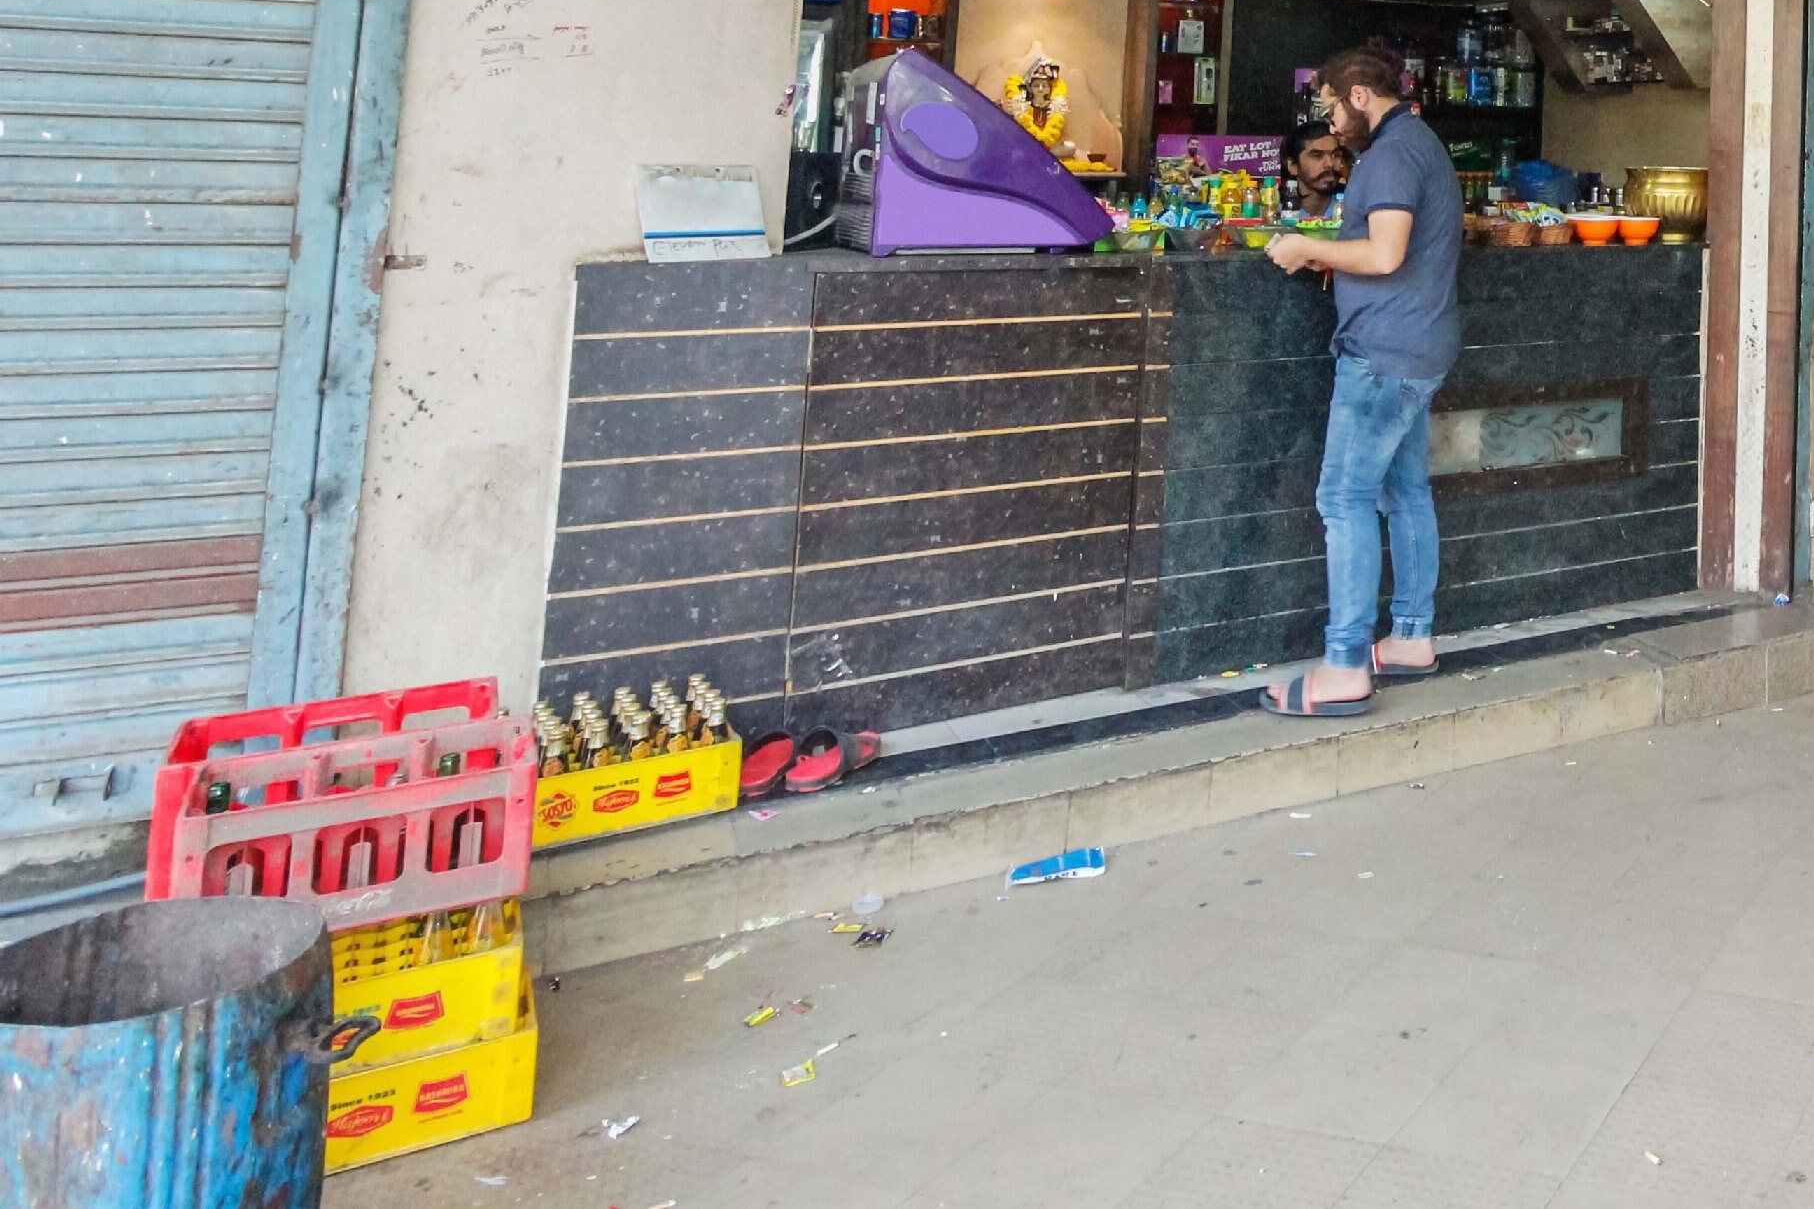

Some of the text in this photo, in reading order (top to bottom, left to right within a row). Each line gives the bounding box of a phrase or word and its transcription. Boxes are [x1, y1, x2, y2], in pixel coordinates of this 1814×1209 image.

[1224, 141, 1272, 154] EAT LOT
[1223, 151, 1259, 163] FIKAR
